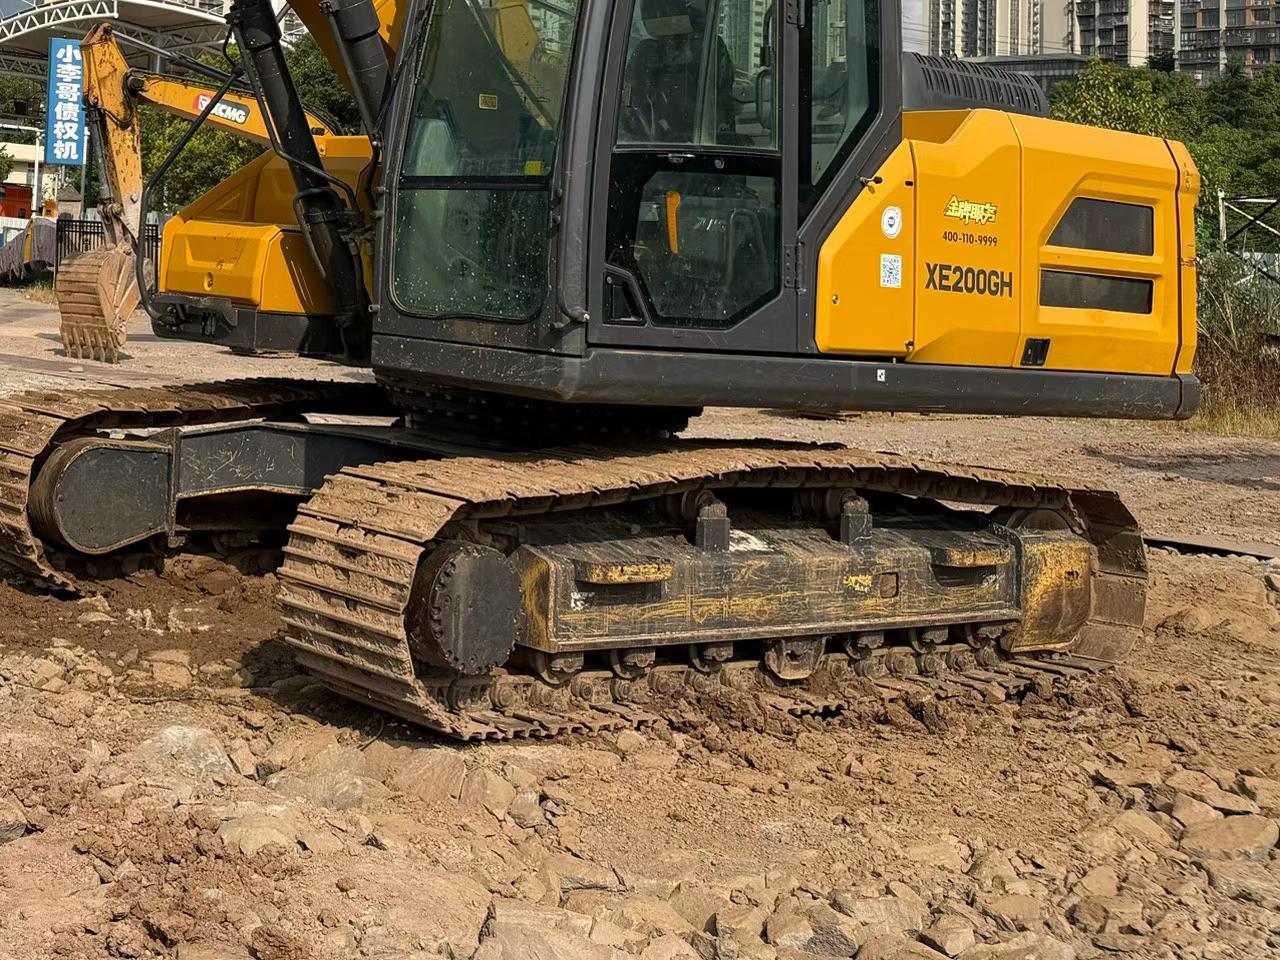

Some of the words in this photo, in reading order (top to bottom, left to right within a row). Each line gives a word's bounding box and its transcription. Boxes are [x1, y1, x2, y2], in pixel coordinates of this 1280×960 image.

[53, 44, 82, 160] 小李哥债权机
[942, 231, 998, 247] 400-110-9999
[925, 262, 1013, 298] XE200GH
